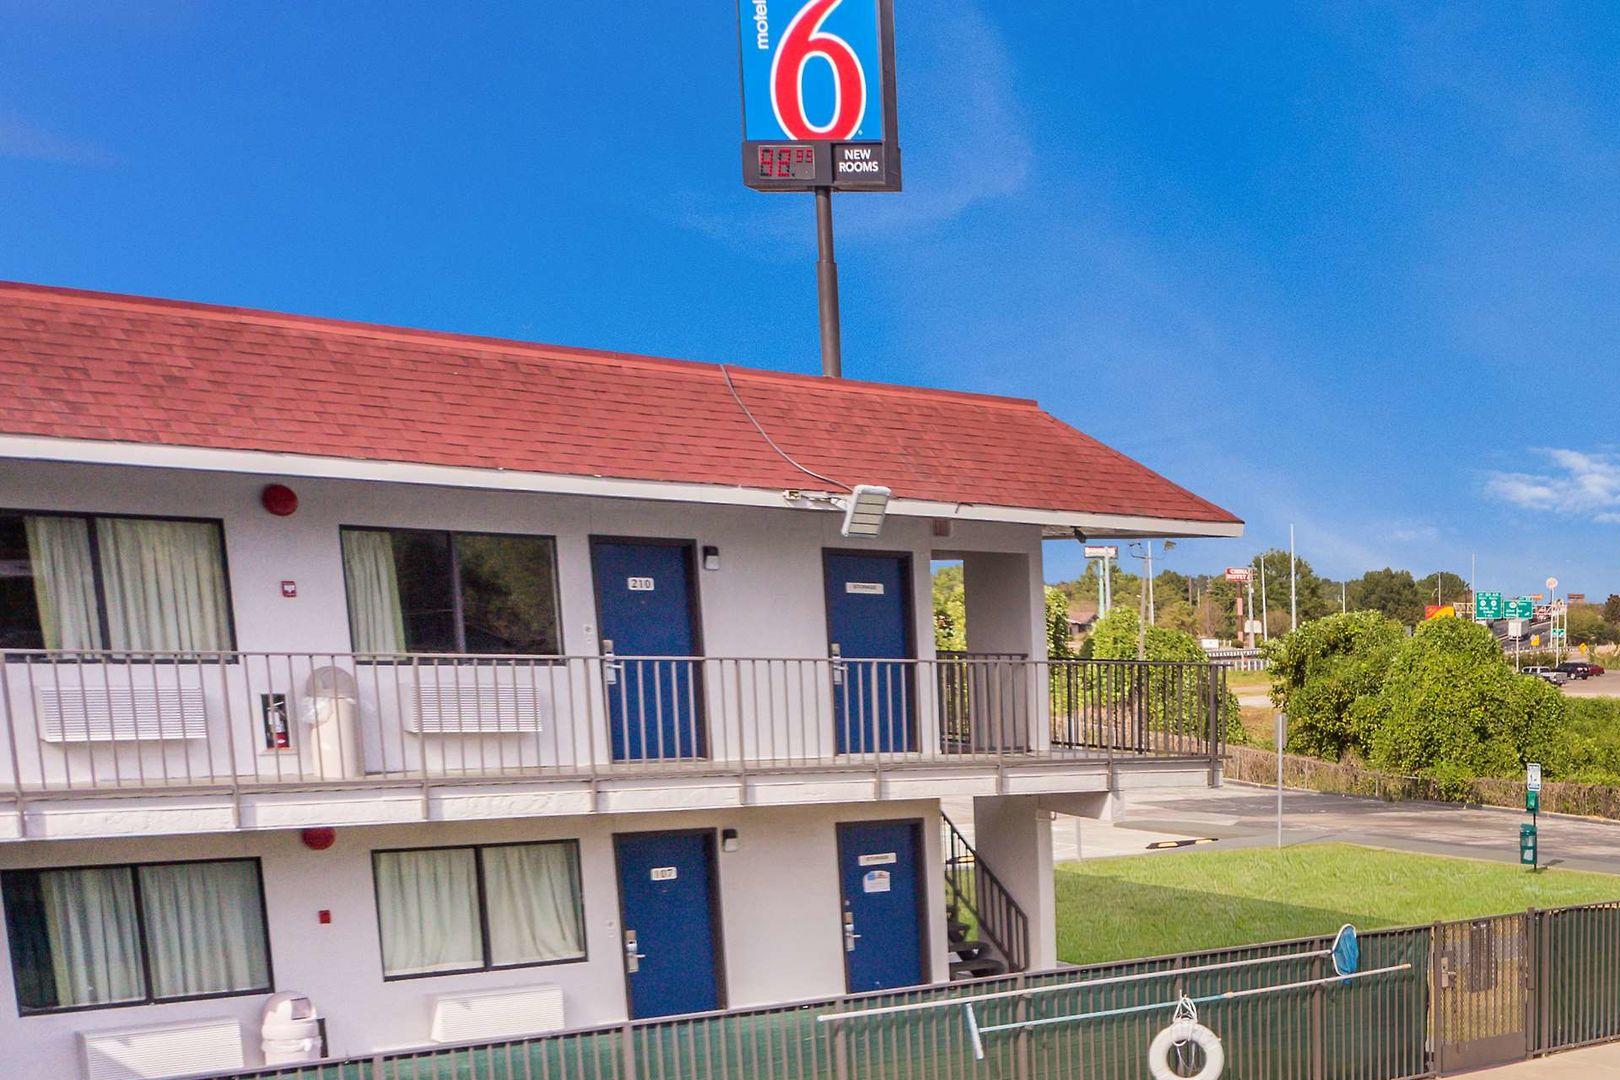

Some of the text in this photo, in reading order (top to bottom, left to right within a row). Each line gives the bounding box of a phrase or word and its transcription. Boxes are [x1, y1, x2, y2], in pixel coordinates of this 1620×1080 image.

[770, 0, 867, 140] 6
[844, 149, 871, 160] NEW
[839, 161, 879, 172] ROOMS
[631, 579, 651, 589] 210
